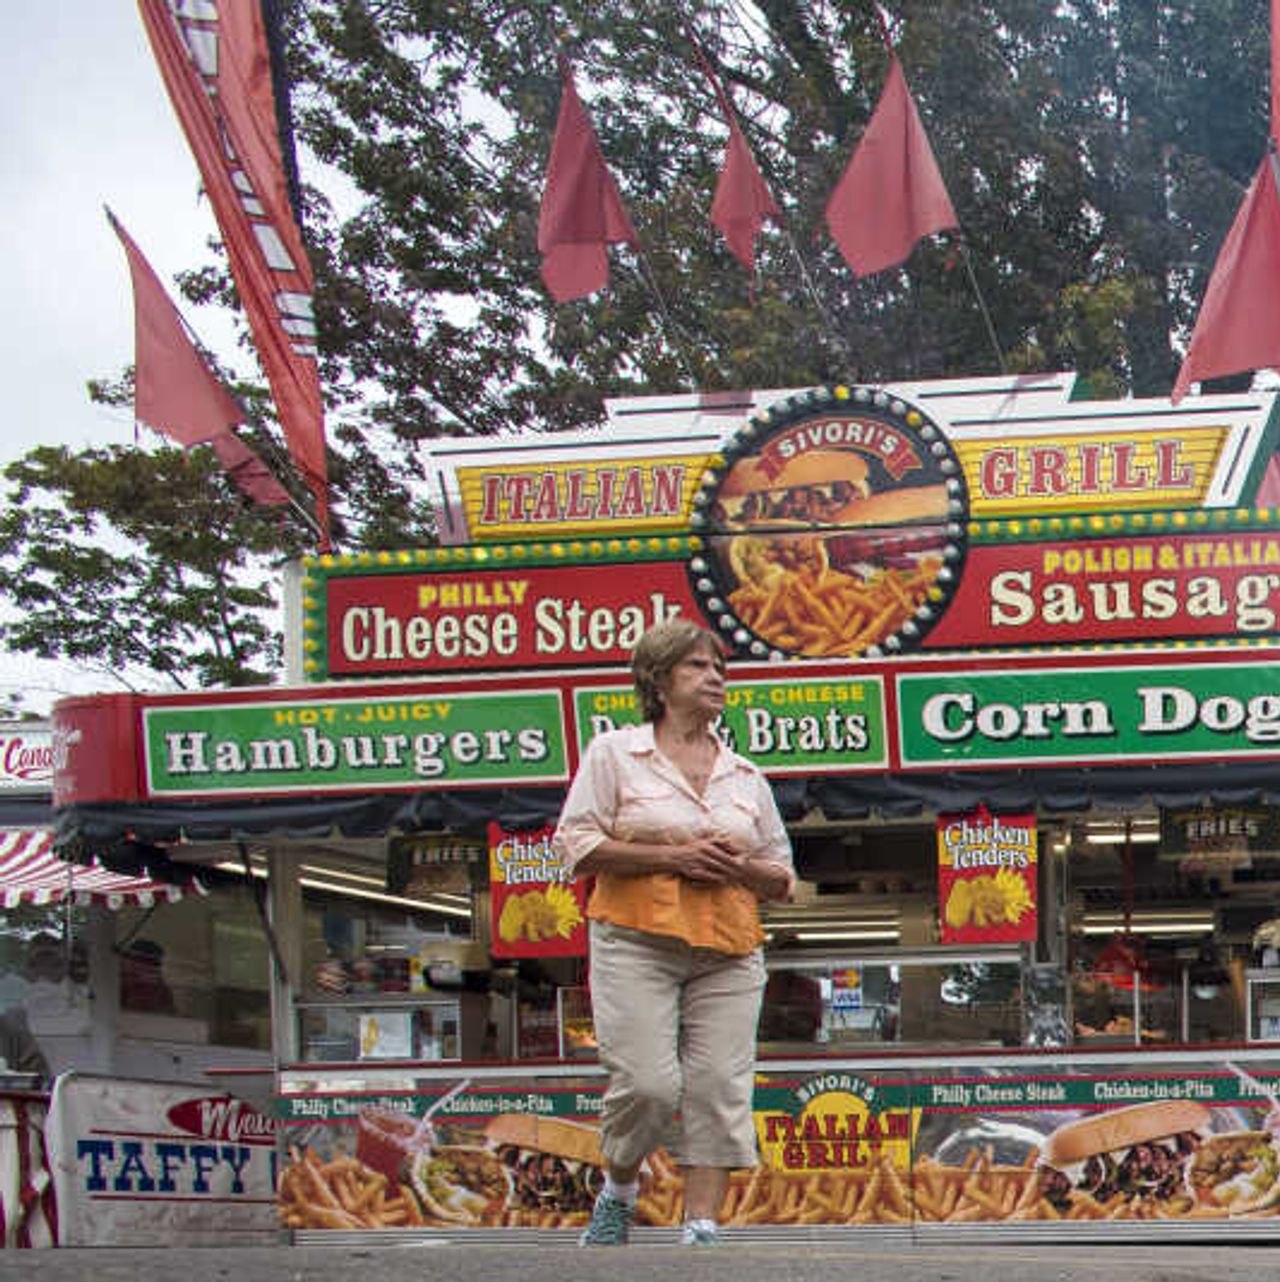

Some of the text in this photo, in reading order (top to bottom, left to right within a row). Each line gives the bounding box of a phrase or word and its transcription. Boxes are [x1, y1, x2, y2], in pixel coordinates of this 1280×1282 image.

[778, 420, 899, 460] SIVORI'S
[980, 437, 1193, 499] GRILL
[480, 465, 686, 526] ITALIAN
[1043, 546, 1153, 574] POLISH
[418, 581, 528, 609] PHILLY
[342, 606, 518, 662] Cheese
[273, 702, 453, 725] HOT JUICY
[747, 709, 870, 755] Brats
[921, 693, 1113, 741] Corn
[165, 716, 549, 776] Hamburgers
[496, 836, 560, 863] Chick
[944, 820, 1030, 848] Chicken
[950, 843, 1029, 870] Tenders
[765, 1113, 909, 1143] ITALIAN
[77, 1140, 251, 1193] TAFFY
